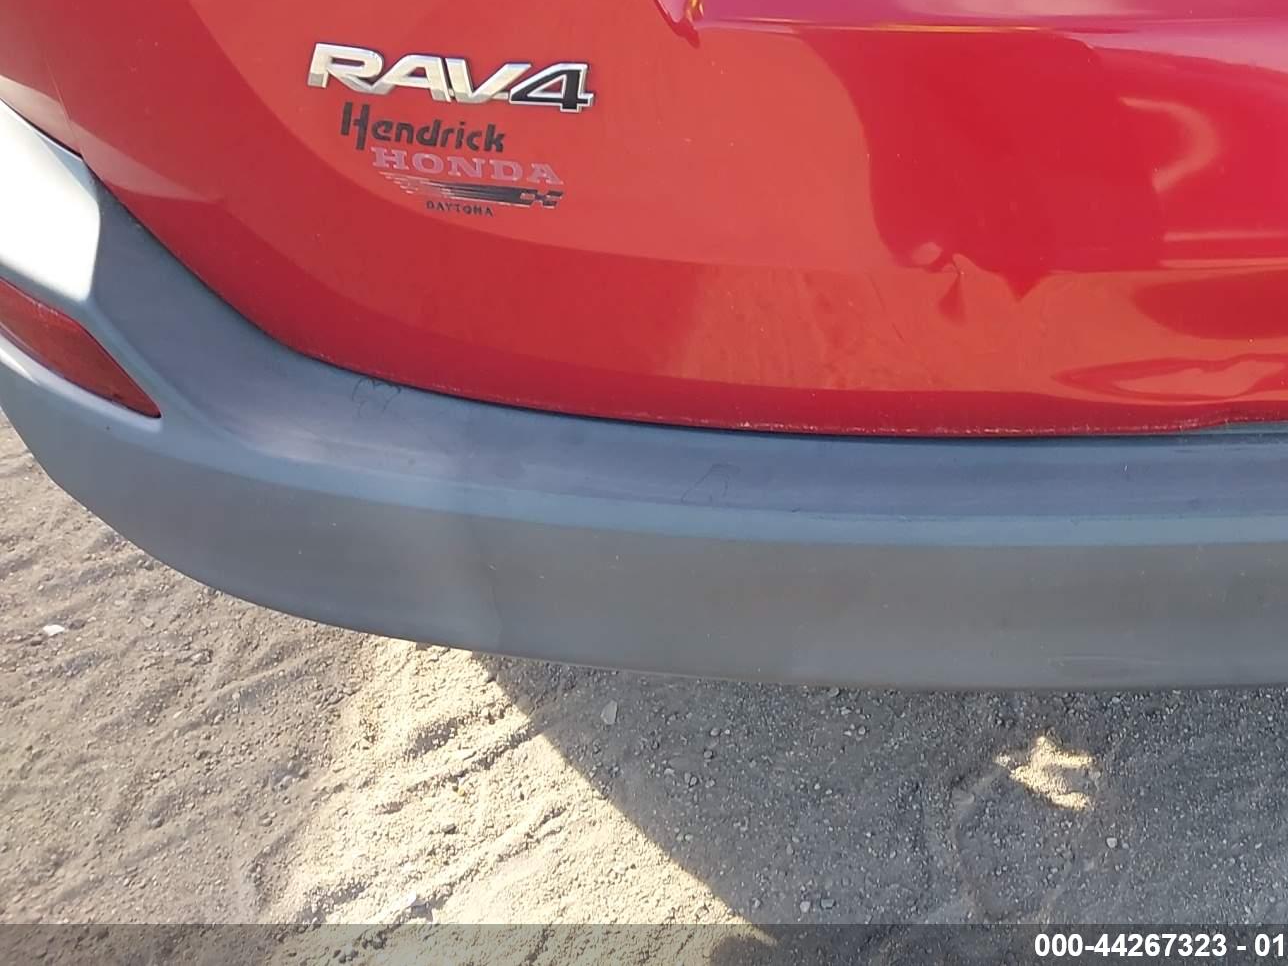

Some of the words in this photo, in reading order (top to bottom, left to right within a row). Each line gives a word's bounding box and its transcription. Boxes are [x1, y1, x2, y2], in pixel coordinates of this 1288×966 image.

[307, 42, 595, 113] RAV4
[340, 101, 505, 153] Hendrick
[371, 146, 564, 185] HONDA
[426, 200, 494, 217] DAYTONA
